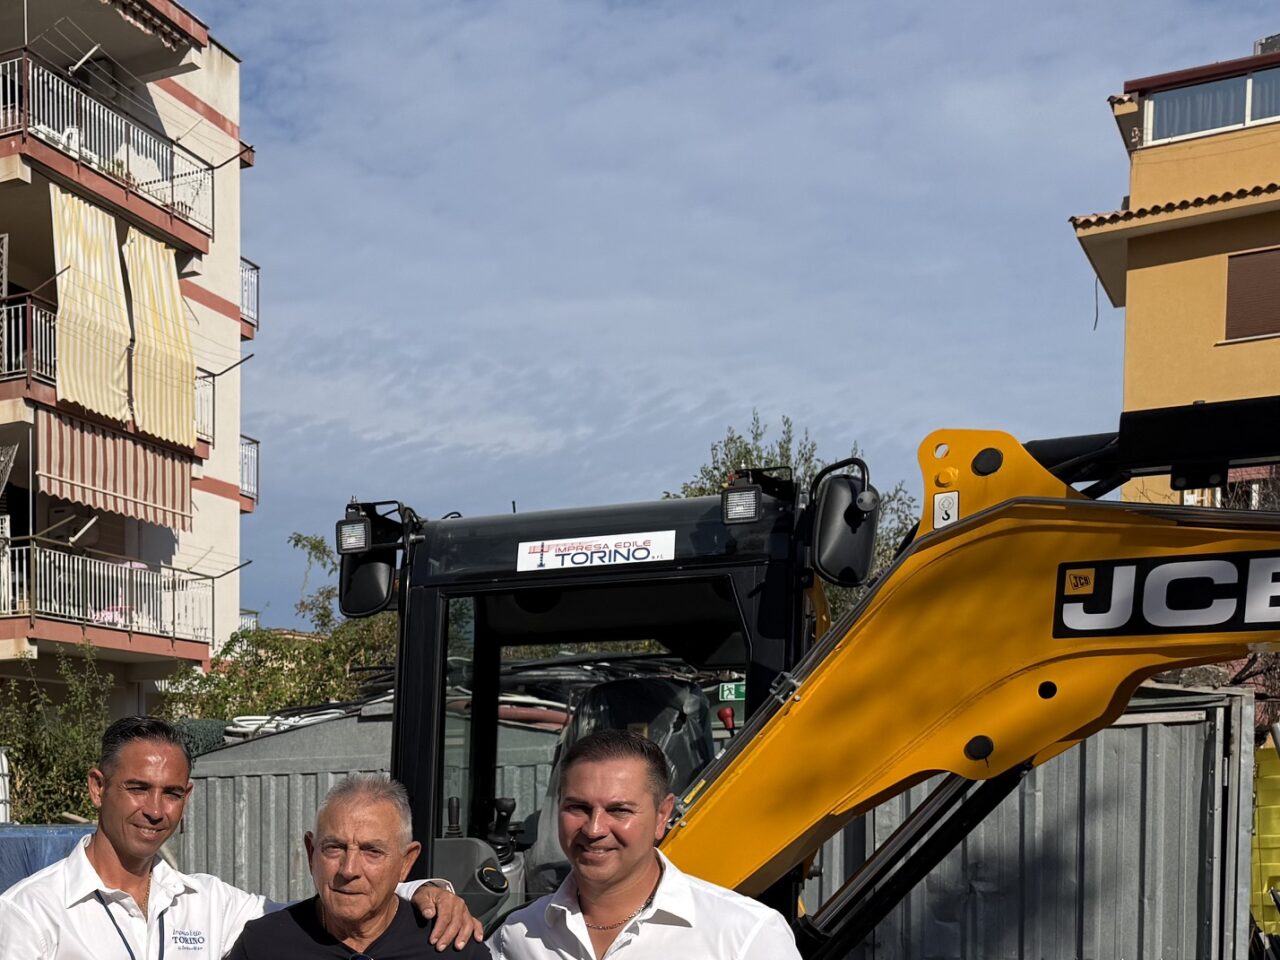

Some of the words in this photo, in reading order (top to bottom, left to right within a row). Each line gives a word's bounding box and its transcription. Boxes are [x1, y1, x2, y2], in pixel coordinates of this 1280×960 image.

[554, 542, 609, 553] IMPRESA
[614, 539, 652, 549] EDILE
[554, 547, 651, 567] TORINO
[1072, 575, 1091, 588] JCB
[171, 936, 205, 945] TORINO
